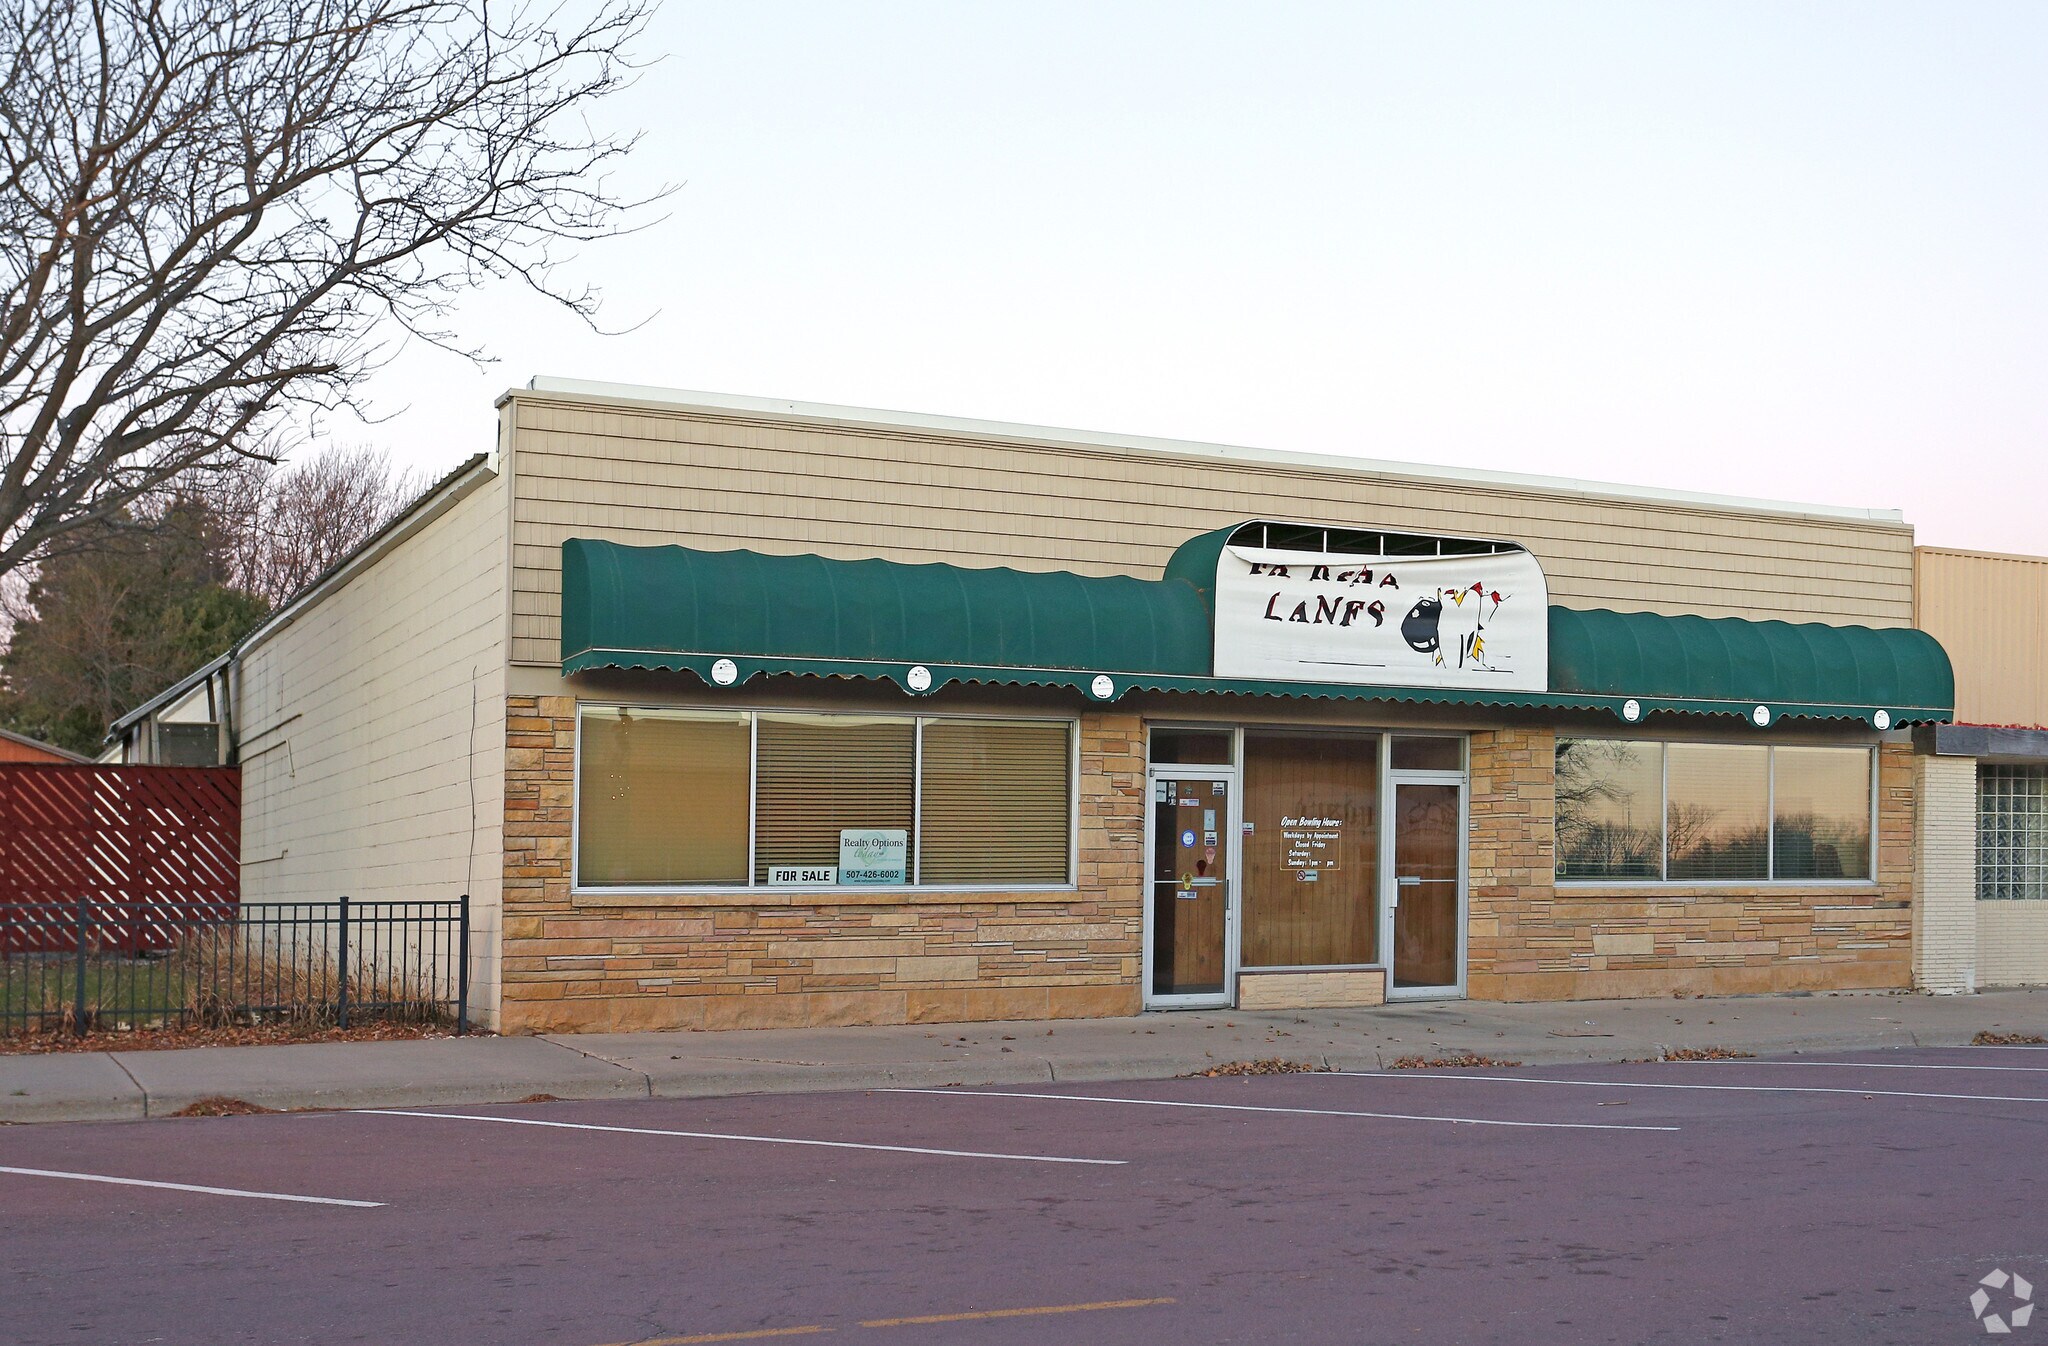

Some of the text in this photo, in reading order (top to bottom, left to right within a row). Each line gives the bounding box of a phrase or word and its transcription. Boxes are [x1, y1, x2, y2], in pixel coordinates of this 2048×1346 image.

[1281, 816, 1342, 828] Open Bowling Hours:
[844, 838, 904, 851] Realty Options
[1312, 841, 1326, 849] Friday
[1288, 859, 1306, 867] Sunday:
[776, 870, 831, 882] FOR SALE
[846, 870, 900, 879] 507-426-6002
